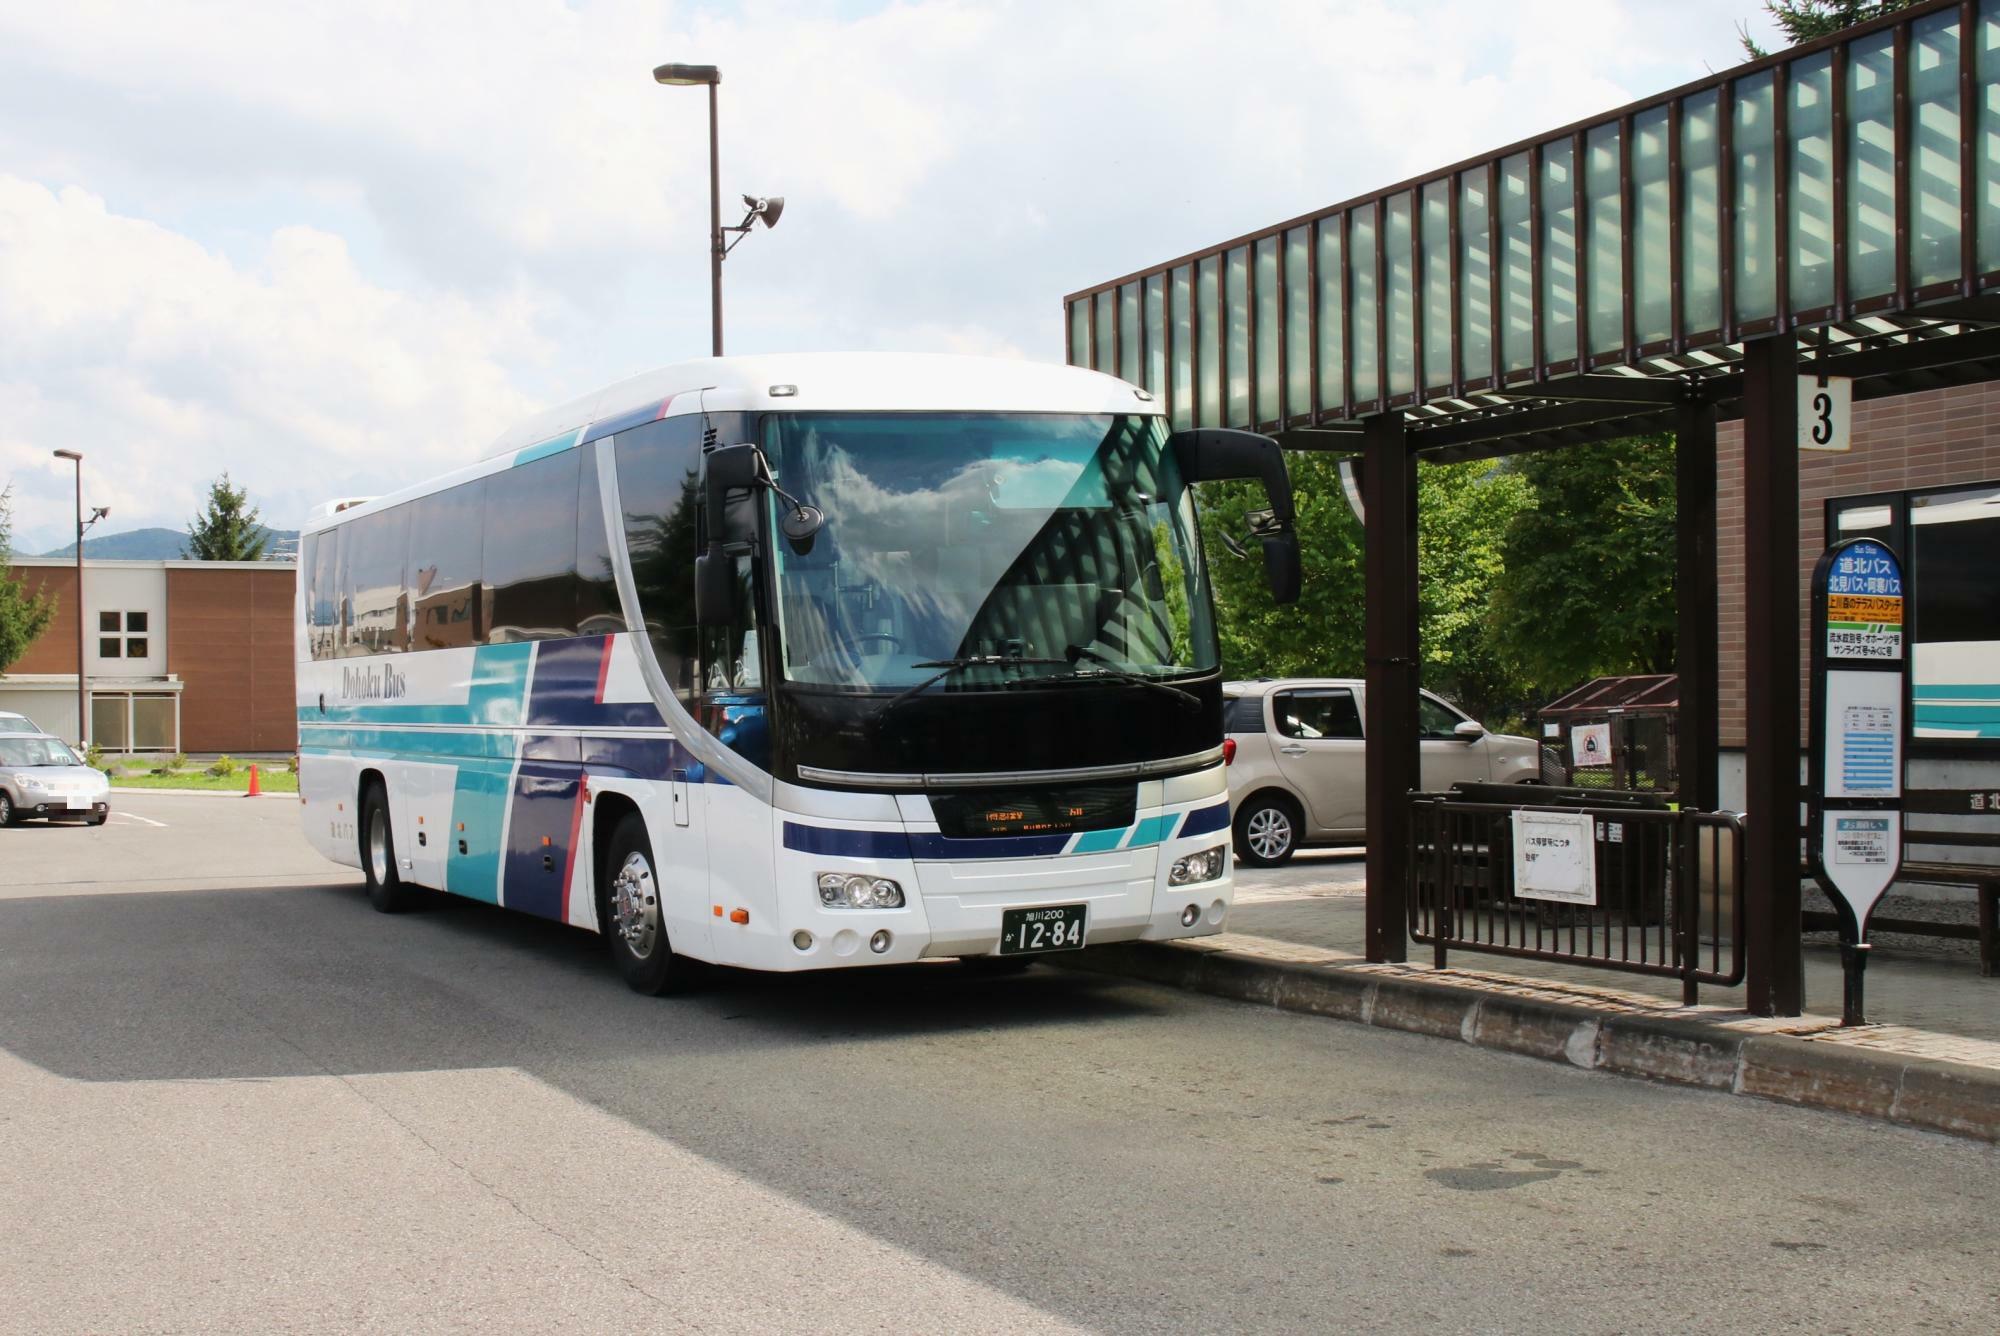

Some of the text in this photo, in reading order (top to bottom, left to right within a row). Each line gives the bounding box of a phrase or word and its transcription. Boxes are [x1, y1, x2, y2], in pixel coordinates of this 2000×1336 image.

[1812, 392, 1833, 445] 3
[1839, 557, 1891, 574] 道北バス
[342, 662, 406, 700] Dohoku Bus
[1019, 920, 1080, 949] 12-84
